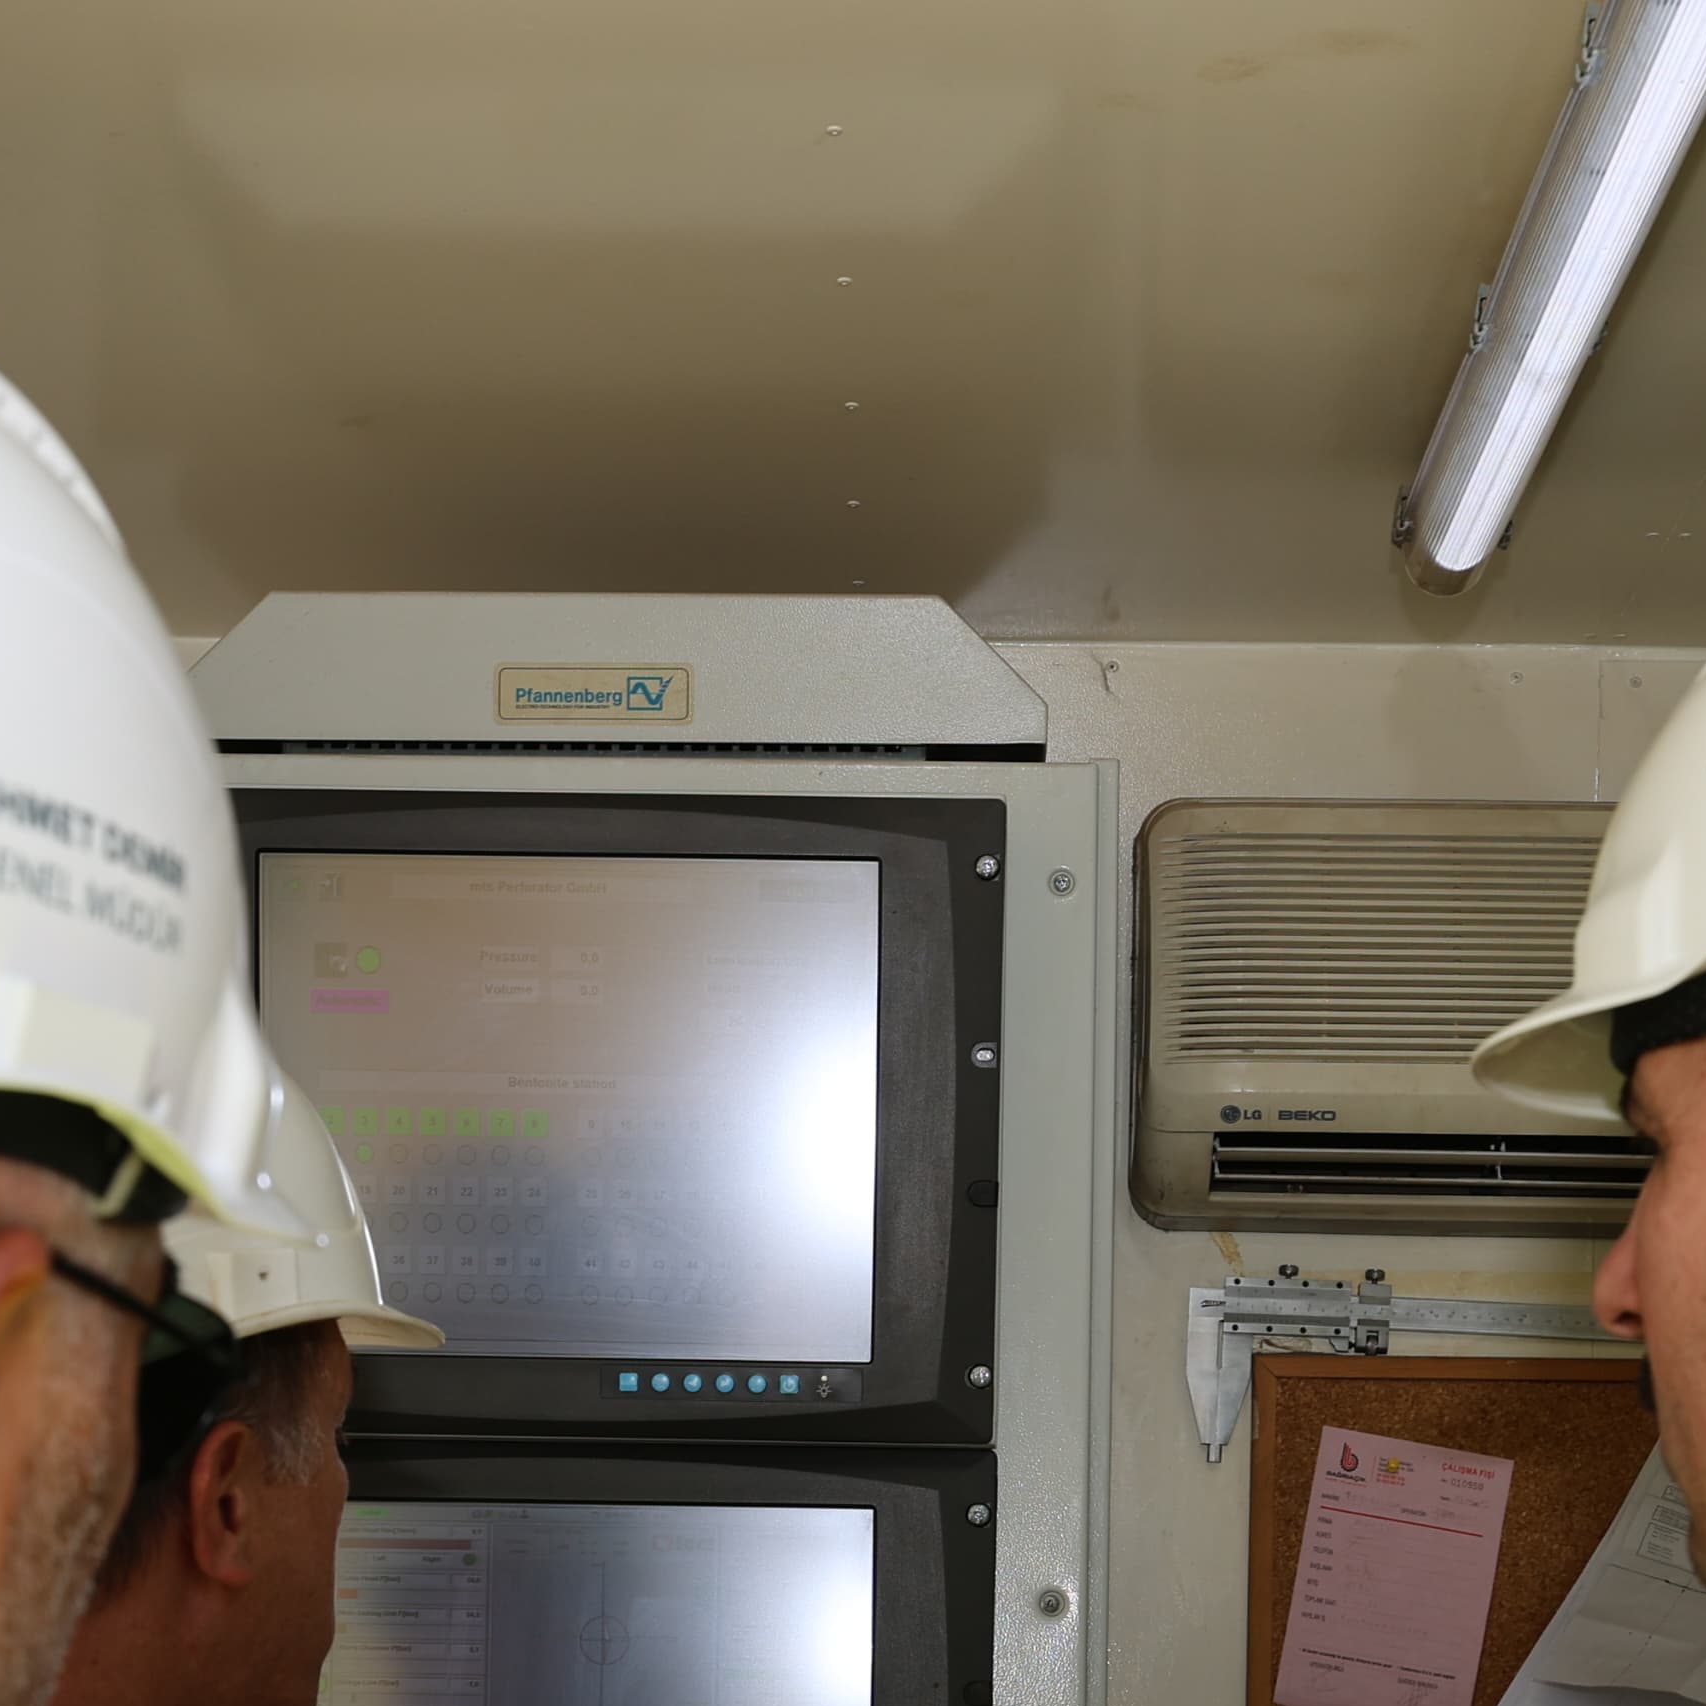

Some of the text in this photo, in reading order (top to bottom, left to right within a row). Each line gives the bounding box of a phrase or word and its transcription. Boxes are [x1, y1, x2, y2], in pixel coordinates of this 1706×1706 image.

[516, 687, 623, 706] Pfannenberg
[479, 949, 538, 963] Pressure
[484, 983, 534, 996] Volume
[1243, 1109, 1337, 1121] LG BEKO
